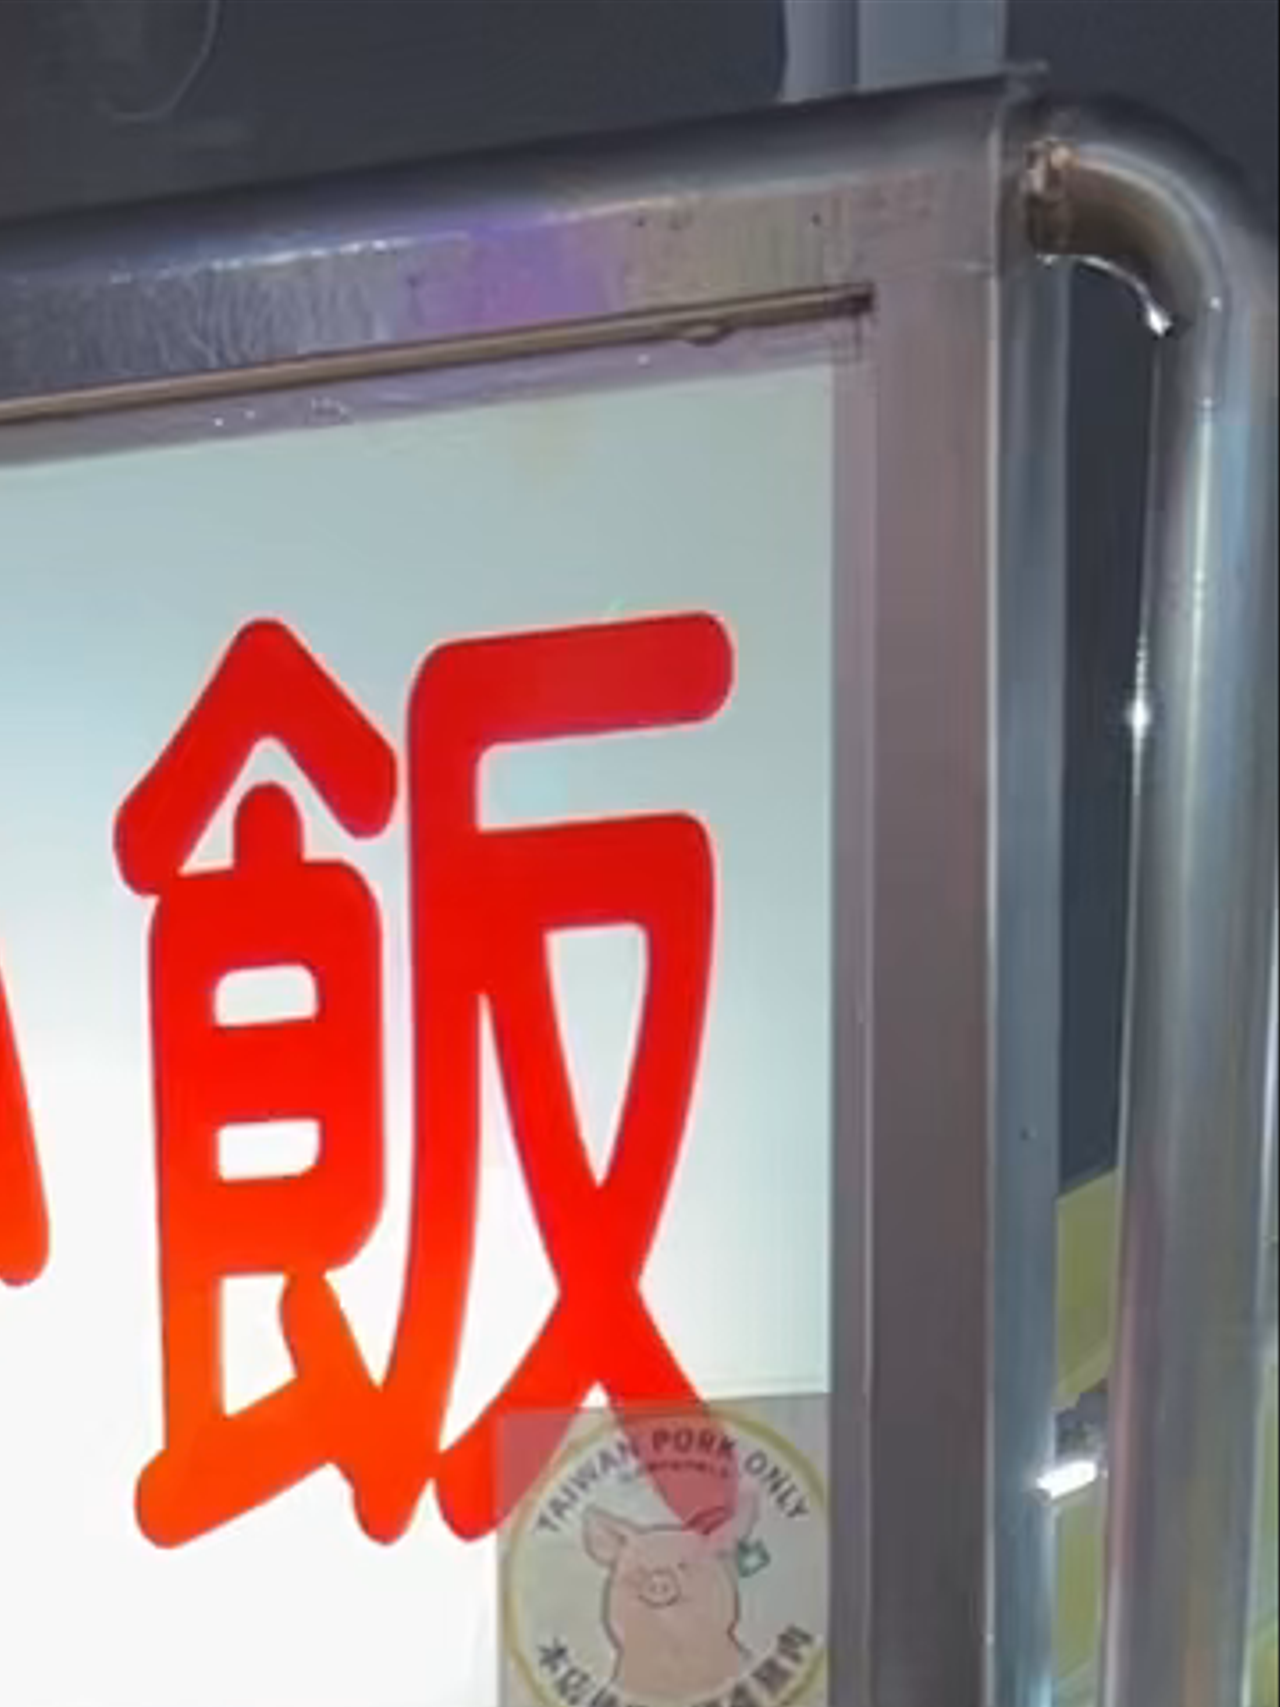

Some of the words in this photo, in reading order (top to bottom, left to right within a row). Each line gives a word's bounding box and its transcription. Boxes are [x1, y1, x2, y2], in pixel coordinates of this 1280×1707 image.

[532, 1438, 640, 1533] TAIWAN
[651, 1428, 737, 1460] PORK
[744, 1449, 810, 1519] ONLY
